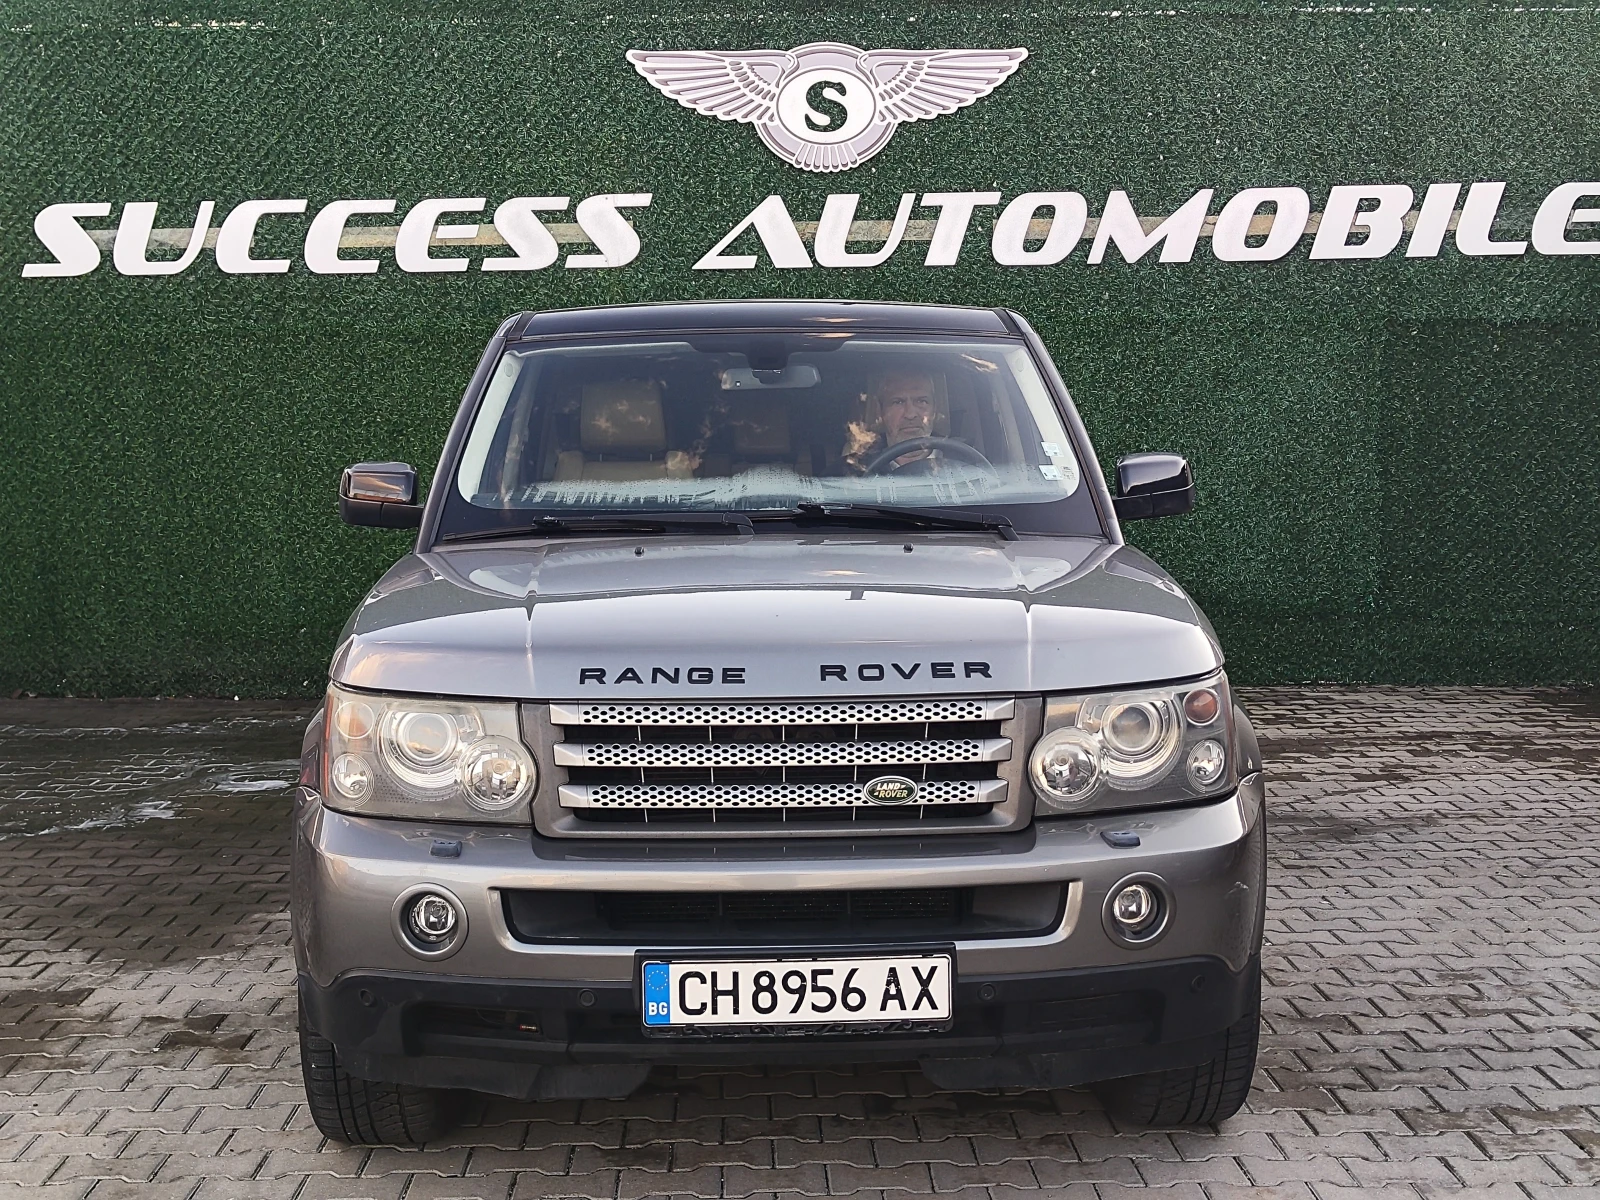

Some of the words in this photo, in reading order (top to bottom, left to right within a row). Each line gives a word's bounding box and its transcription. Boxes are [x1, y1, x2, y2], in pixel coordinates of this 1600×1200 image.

[804, 80, 848, 132] S
[21, 193, 653, 279] SUCCESS
[692, 182, 1600, 270] AUTOMOBILE
[579, 667, 746, 685] RANGE
[820, 661, 993, 682] ROVER
[877, 782, 901, 791] LAND
[879, 789, 908, 798] ROVER
[678, 970, 740, 1016] CH
[751, 966, 867, 1015] 8956
[879, 965, 939, 1012] AX
[648, 1001, 668, 1016] BG
